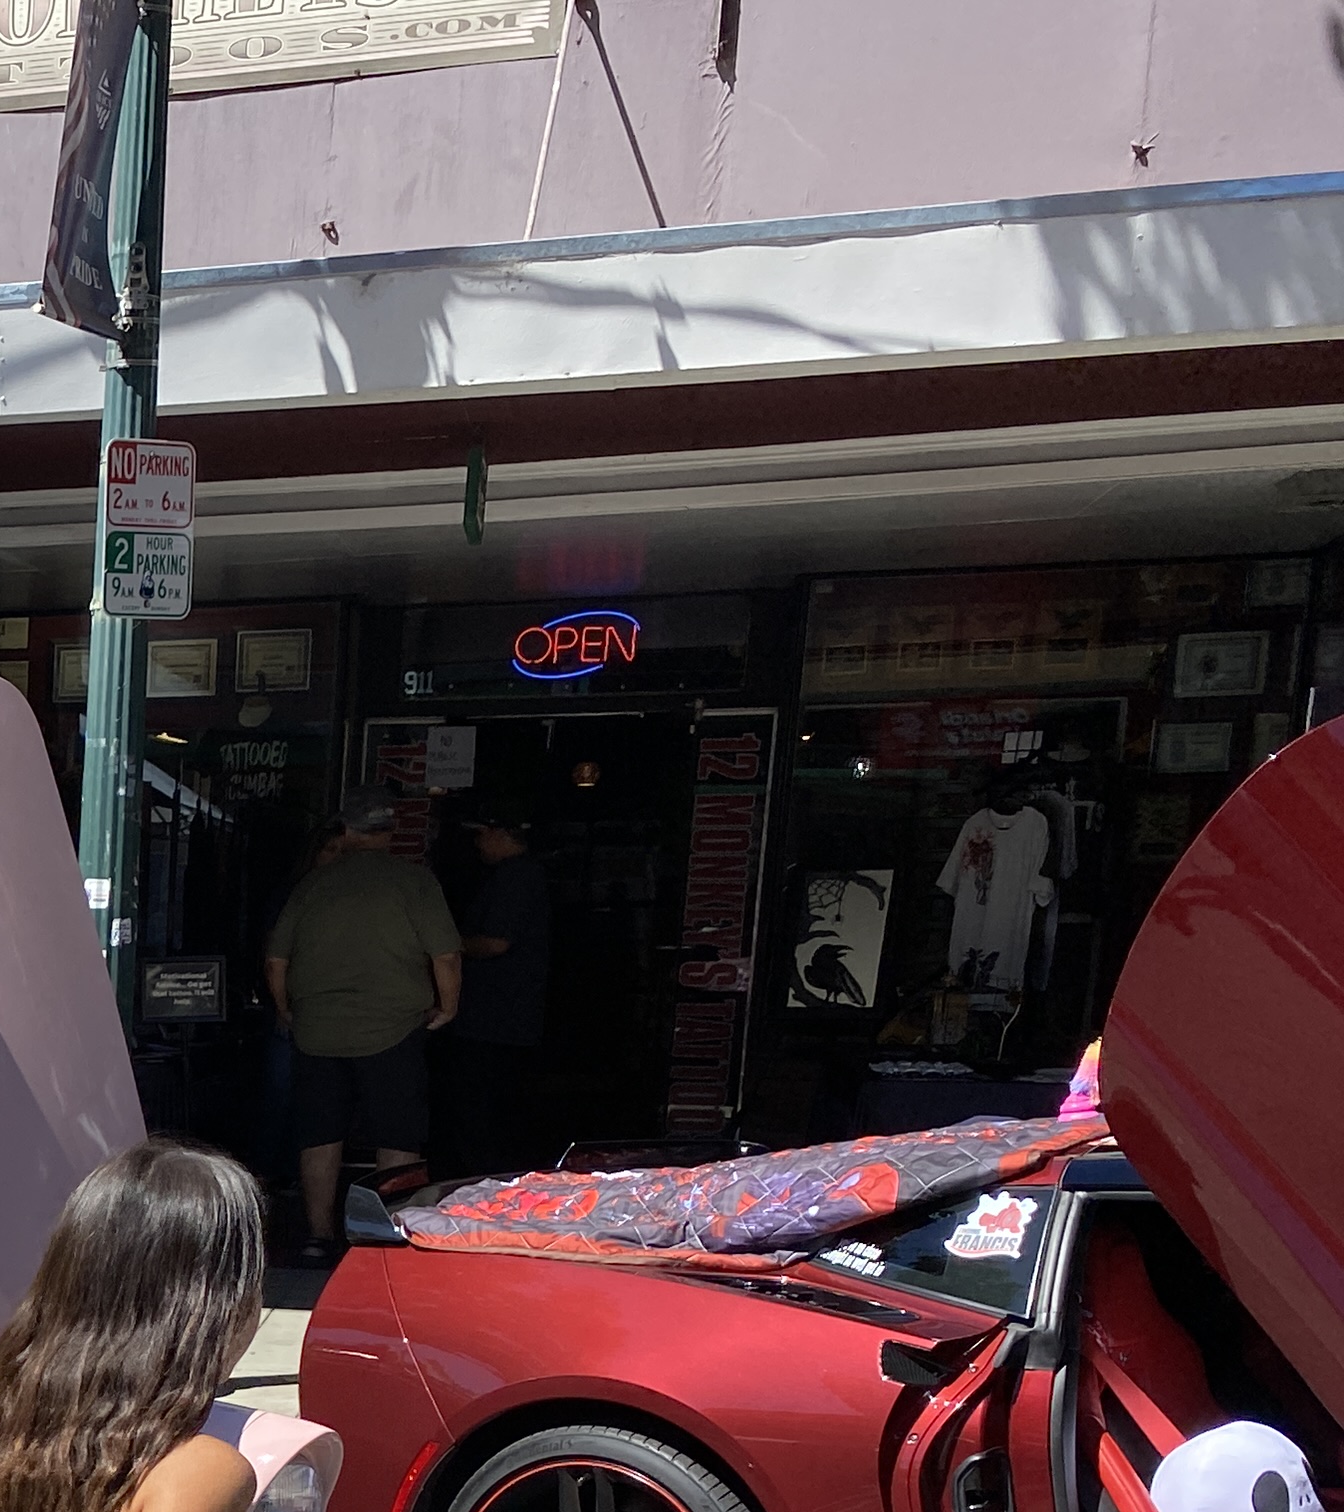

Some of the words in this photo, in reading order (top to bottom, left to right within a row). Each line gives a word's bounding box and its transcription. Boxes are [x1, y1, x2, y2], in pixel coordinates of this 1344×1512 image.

[69, 254, 103, 290] PRIDE
[112, 446, 136, 479] NO
[139, 454, 189, 477] PARKING
[114, 537, 129, 570] 2
[146, 537, 173, 550] HOUR
[137, 554, 186, 576] PARKING
[514, 626, 639, 665] OPEN
[404, 671, 434, 695] 911
[697, 732, 761, 781] 12
[667, 999, 737, 1138] TATTOO
[952, 1233, 1018, 1251] FRANCIS
